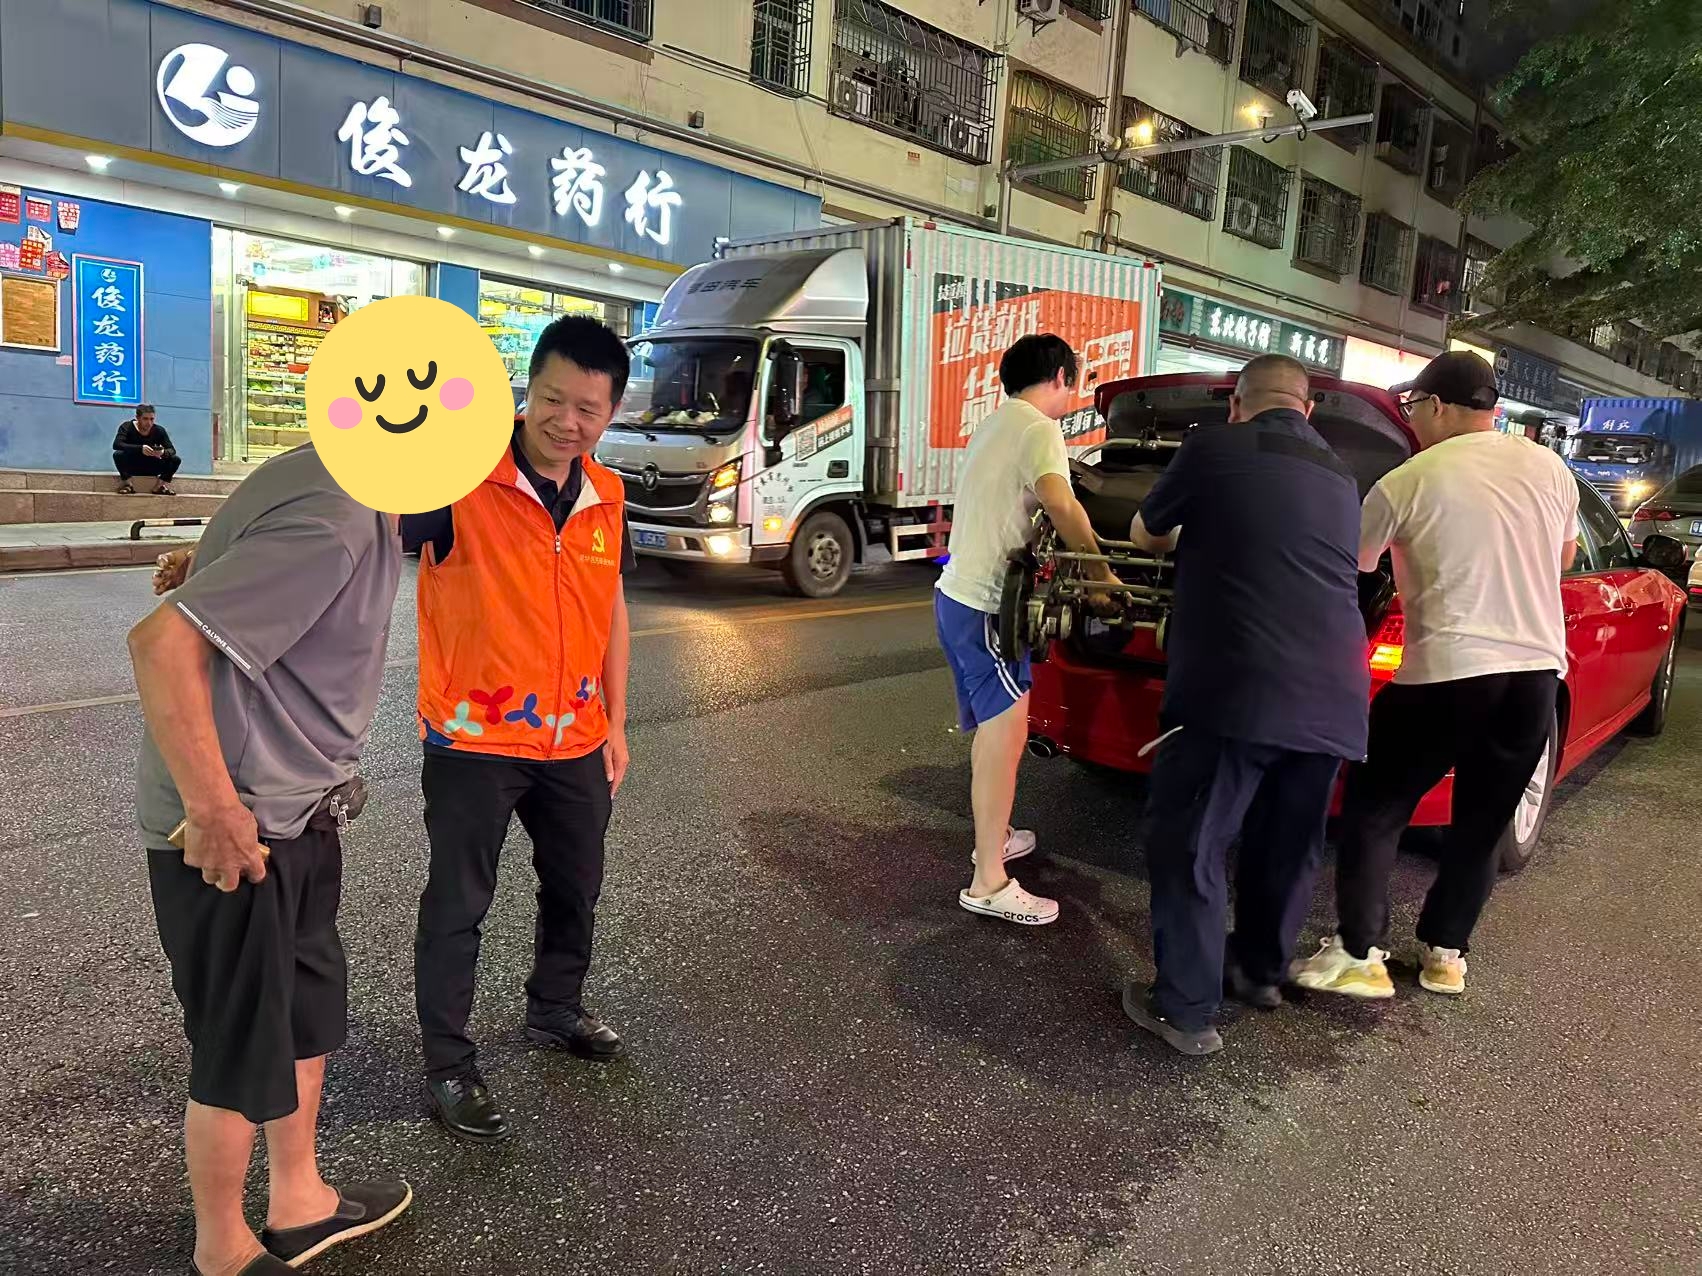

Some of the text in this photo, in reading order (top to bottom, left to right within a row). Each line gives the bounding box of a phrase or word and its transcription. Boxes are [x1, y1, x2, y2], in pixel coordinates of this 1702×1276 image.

[338, 96, 682, 245] 俊龙药行
[91, 285, 127, 394] 俊龙药行
[202, 624, 228, 648] CALVINS
[1003, 911, 1040, 922] crocs
